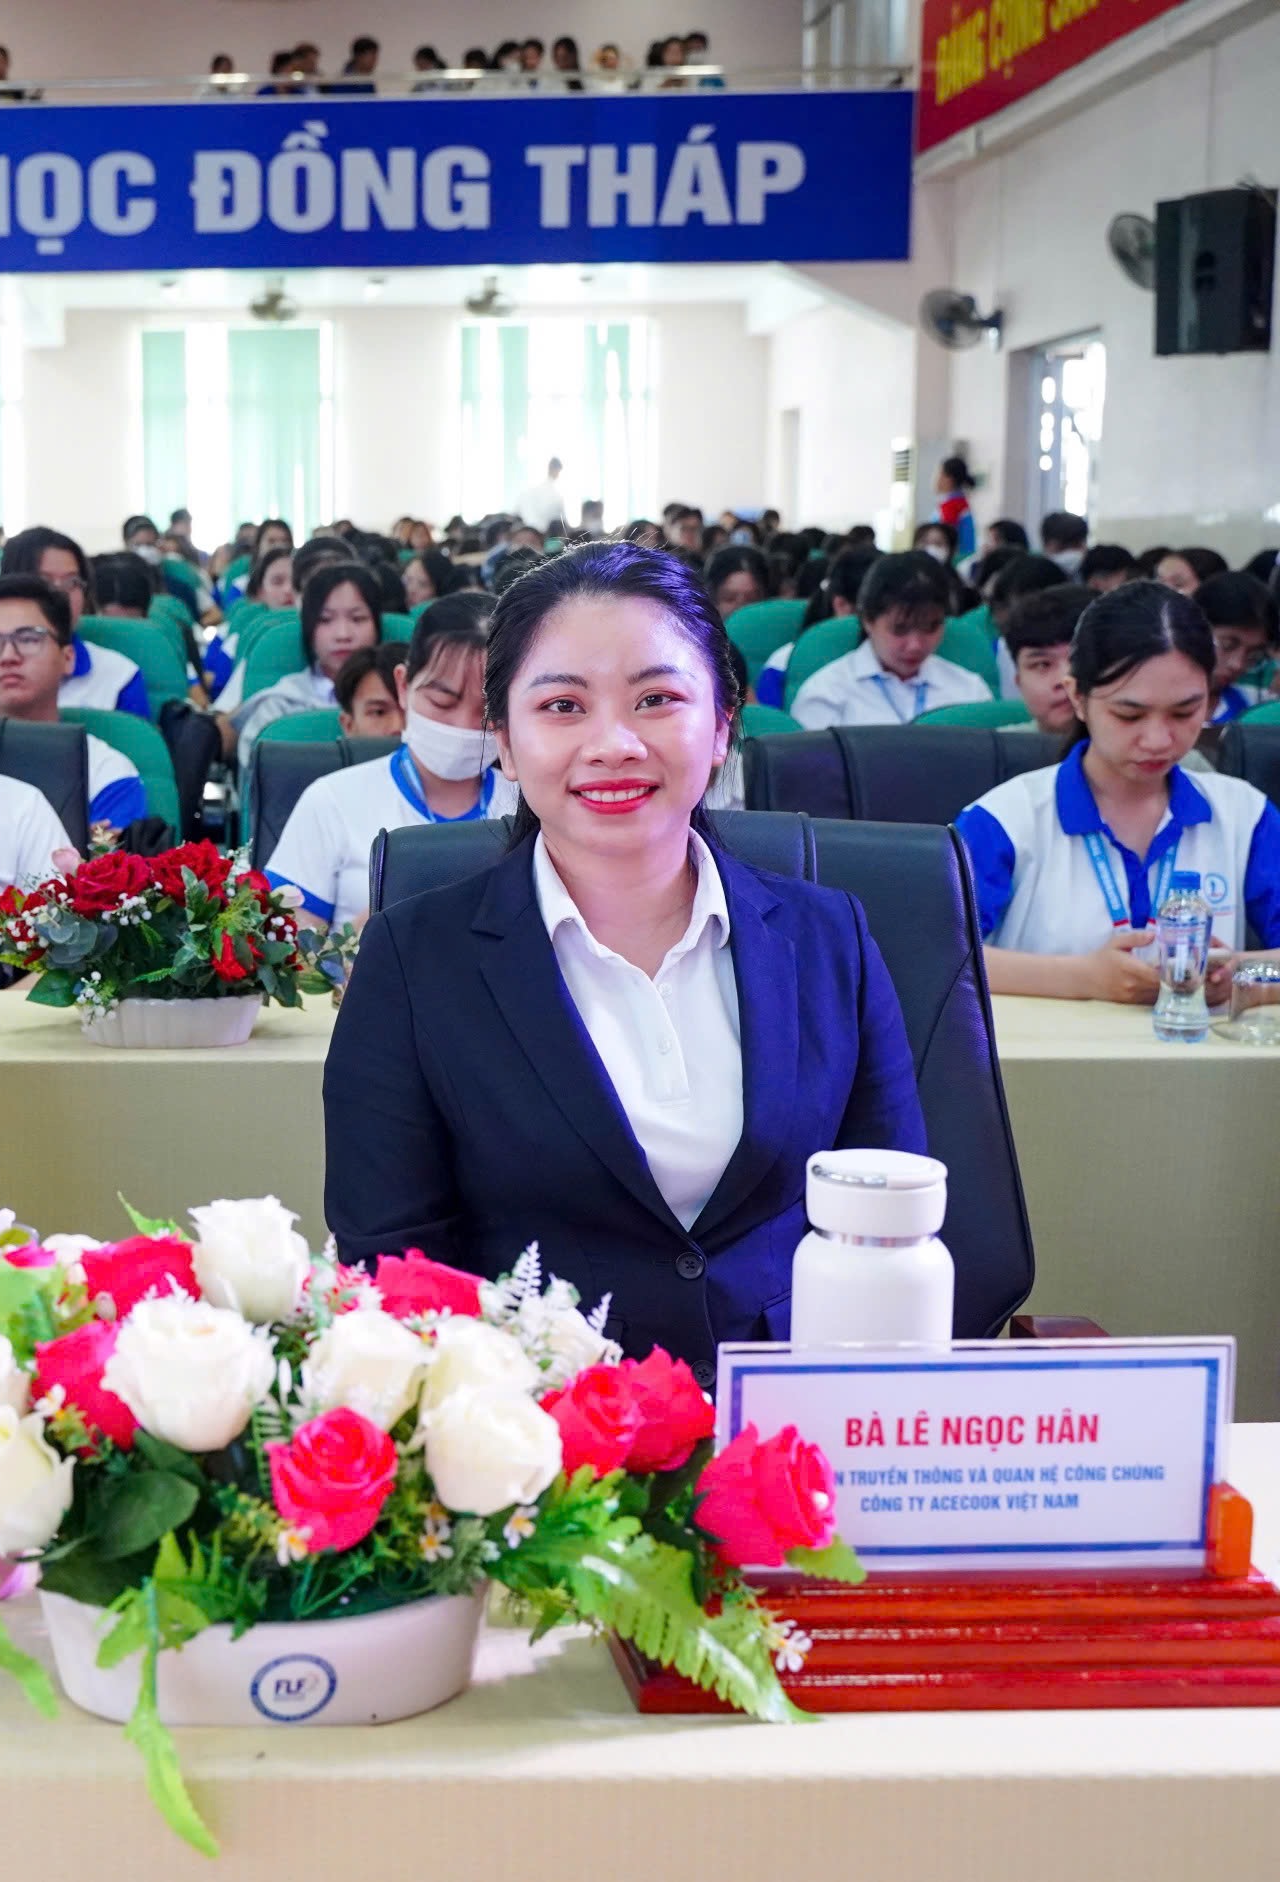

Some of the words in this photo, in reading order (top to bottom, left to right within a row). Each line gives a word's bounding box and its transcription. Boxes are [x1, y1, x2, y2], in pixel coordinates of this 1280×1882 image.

[189, 120, 492, 234] ĐỒNG
[524, 123, 807, 231] THÁP
[845, 1411, 885, 1447] BÀ
[895, 1410, 930, 1446] LÊ
[941, 1415, 1025, 1452] NGỌC
[1035, 1408, 1099, 1444] HÂN
[913, 1465, 963, 1484] THÔNG
[969, 1464, 988, 1483] VÀ
[992, 1467, 1035, 1484] QUAN
[1040, 1465, 1059, 1485] HỆ
[1064, 1463, 1107, 1481] CÔNG
[1112, 1461, 1165, 1481] CHÚNG
[860, 1493, 903, 1512] CÔNG
[908, 1497, 926, 1512] TY
[930, 1495, 1001, 1511] ACECOOK
[1006, 1491, 1038, 1512] VIỆT
[1042, 1493, 1079, 1509] NAM
